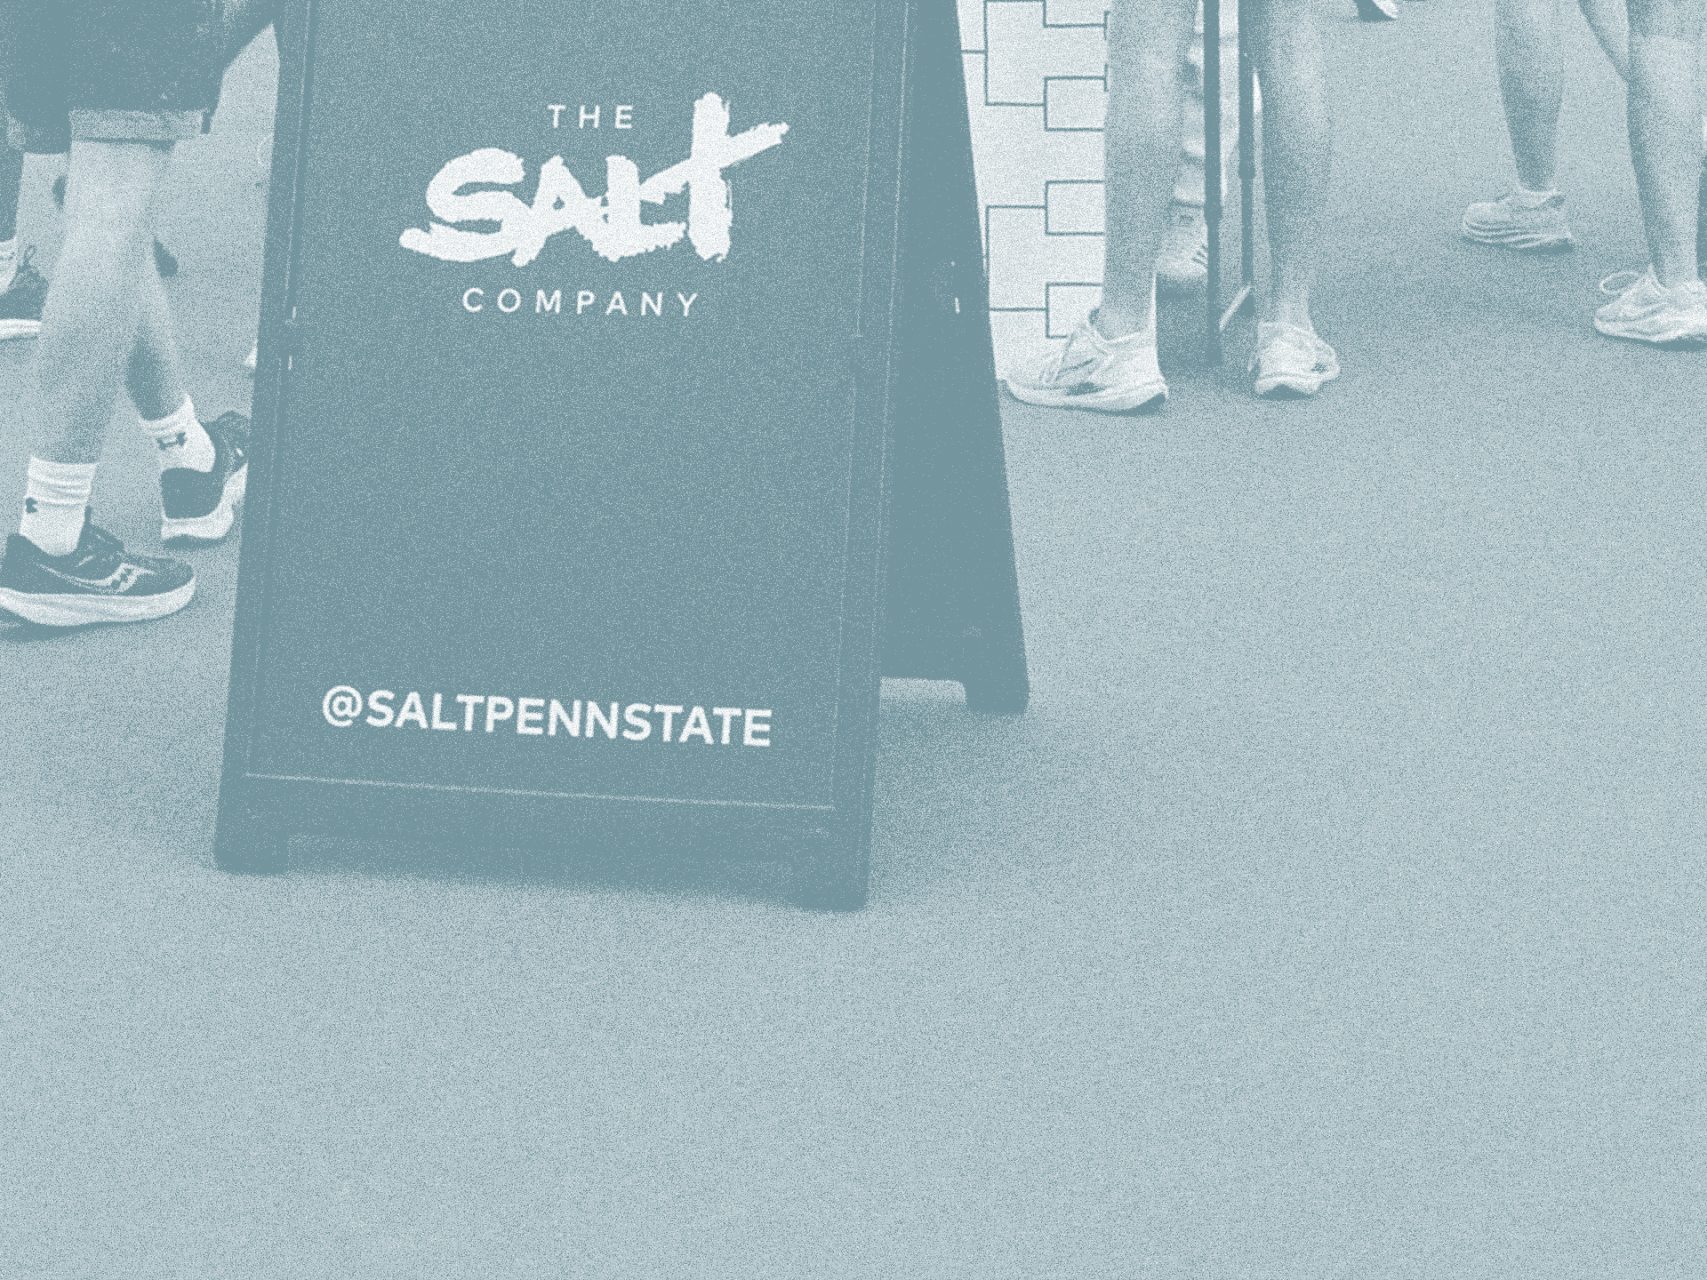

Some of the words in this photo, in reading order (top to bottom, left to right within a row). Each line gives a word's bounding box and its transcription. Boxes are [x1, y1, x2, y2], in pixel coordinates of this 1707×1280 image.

[548, 104, 634, 130] THE
[462, 287, 698, 317] COMPANY
[321, 684, 773, 747] @SALTPENNSTATE
